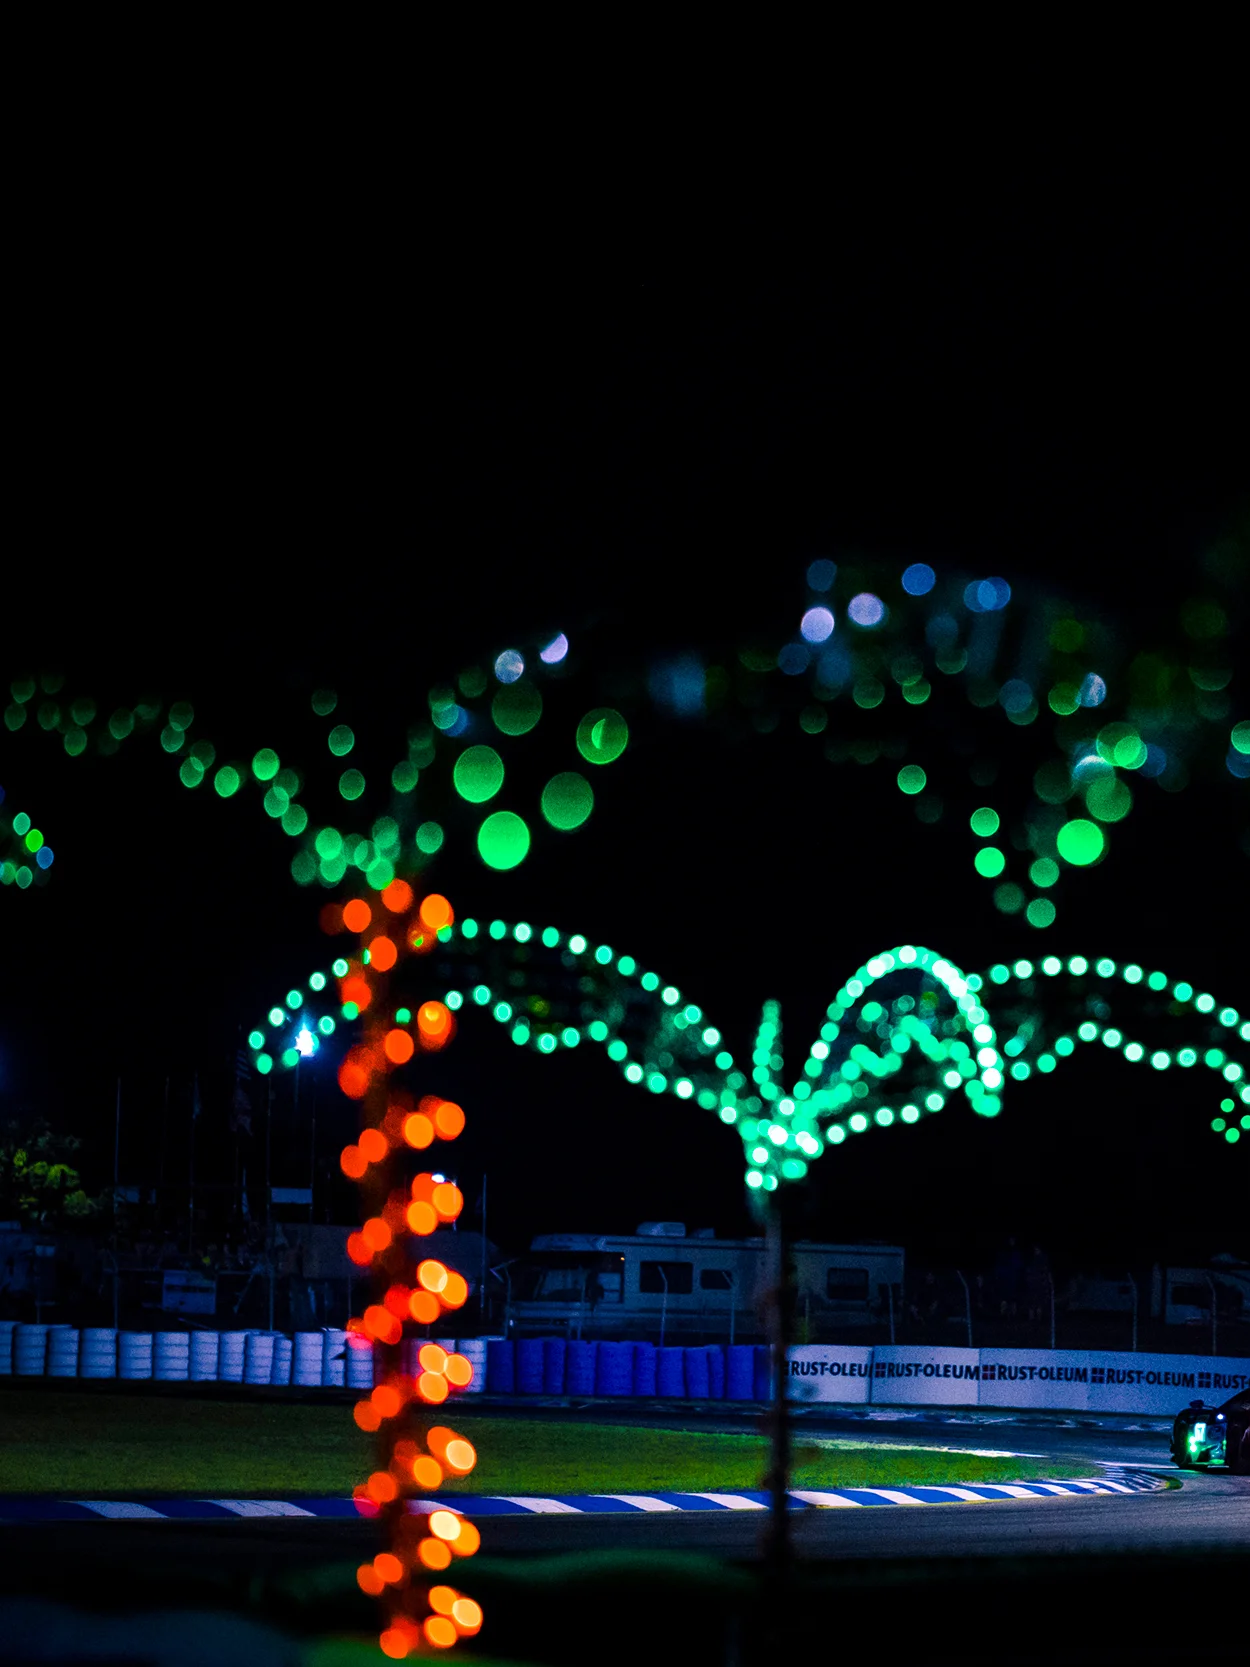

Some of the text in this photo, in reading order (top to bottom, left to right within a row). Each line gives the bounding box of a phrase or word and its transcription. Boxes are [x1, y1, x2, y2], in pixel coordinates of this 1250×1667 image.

[887, 1362, 979, 1380] RUST-OLEUM
[998, 1364, 1087, 1383] RUST-OLEUM
[1106, 1367, 1195, 1388] RUST-OLEUM
